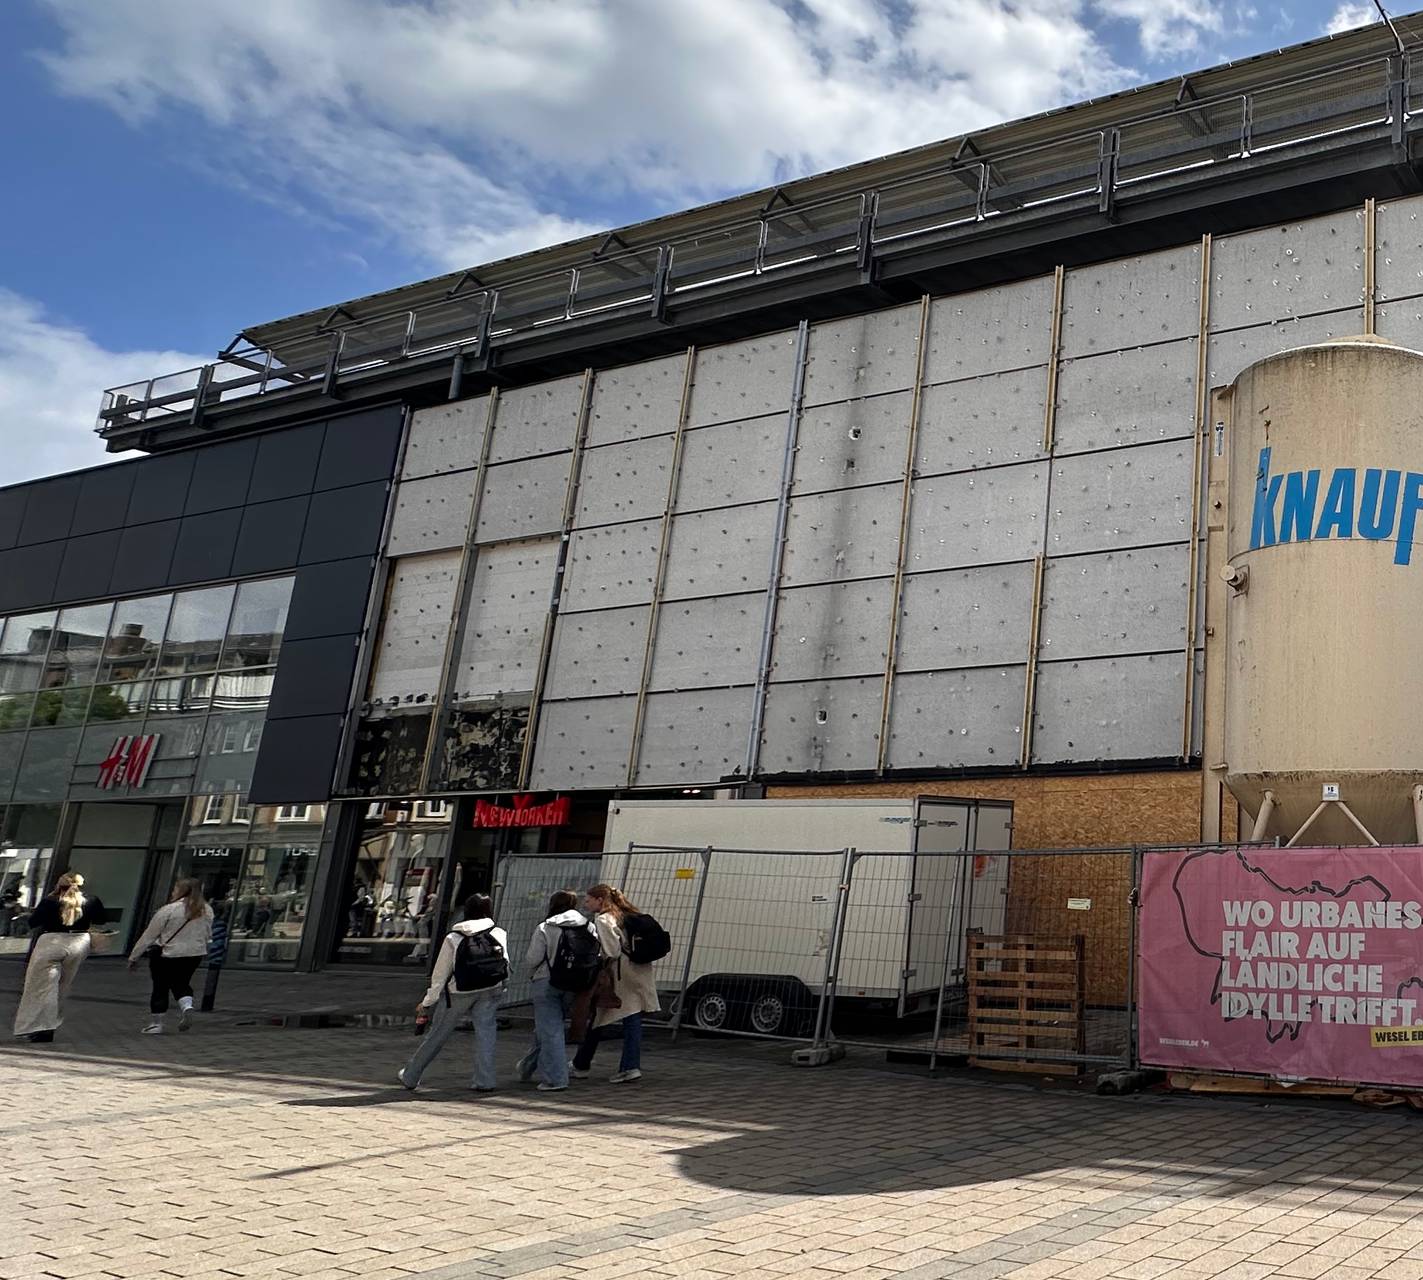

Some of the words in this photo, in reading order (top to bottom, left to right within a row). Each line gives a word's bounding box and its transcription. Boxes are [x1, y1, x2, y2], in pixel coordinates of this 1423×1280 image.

[96, 734, 160, 789] H&M
[1223, 900, 1274, 928] WO
[1280, 901, 1422, 930] URBANES
[1222, 930, 1300, 959] FLAIR
[1306, 931, 1366, 960] AUF
[1221, 952, 1383, 993] LÄNDLICHE
[1221, 991, 1312, 1022] IDYLLE
[1318, 996, 1423, 1027] TRIFFT.
[1375, 1030, 1410, 1043] WESEL
